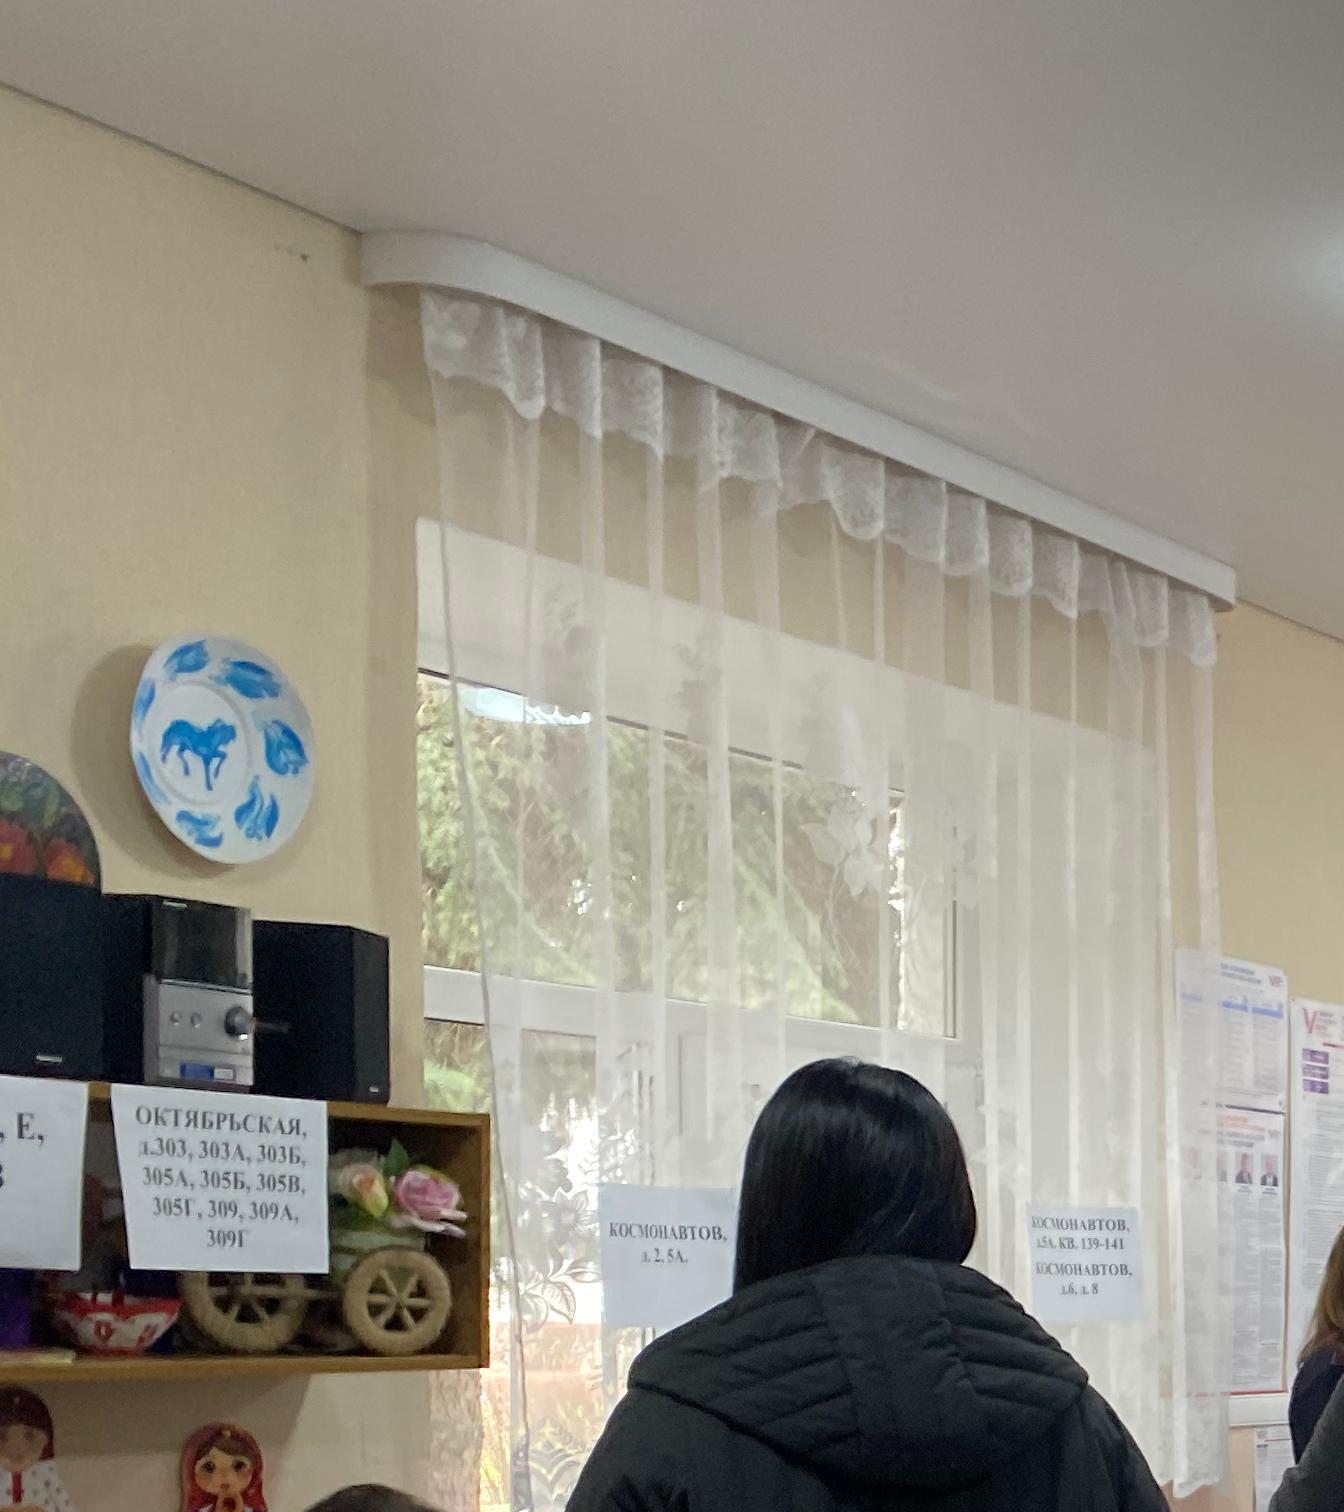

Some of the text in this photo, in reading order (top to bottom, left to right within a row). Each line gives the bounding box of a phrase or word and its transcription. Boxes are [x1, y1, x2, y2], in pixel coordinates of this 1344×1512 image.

[135, 1106, 307, 1138] ОКТЯБРЬСКАЯ,
[198, 1141, 251, 1164] 303А,
[257, 1144, 307, 1167] 303Б,
[143, 1167, 306, 1196] 305А, 305Б, 305В,
[208, 1200, 243, 1222] 309,
[249, 1202, 299, 1224] 309А,
[609, 1222, 727, 1242] КОСМОНАВТОВ,
[1032, 1216, 1130, 1233] КОСМОНАВТОВ,
[207, 1230, 249, 1248] 309Г
[1081, 1238, 1124, 1250] 139-141
